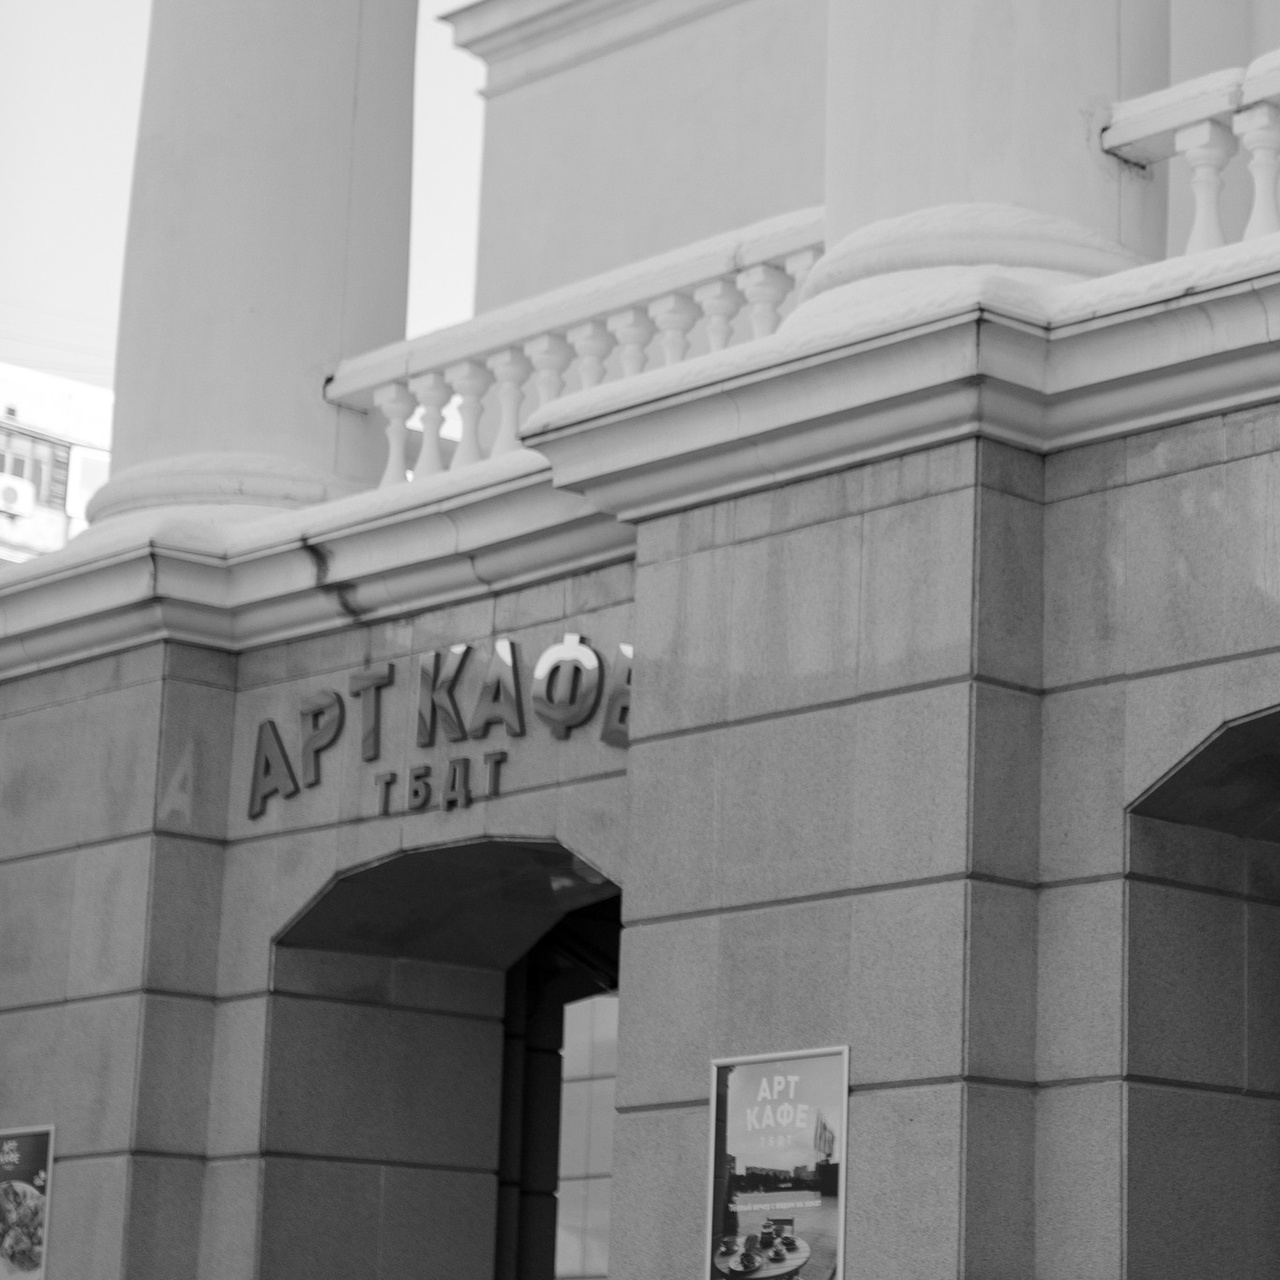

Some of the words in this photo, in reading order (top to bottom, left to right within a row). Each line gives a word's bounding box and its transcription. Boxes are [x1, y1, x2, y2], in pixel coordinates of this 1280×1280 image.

[247, 663, 395, 819] АРТ
[374, 751, 508, 816] ТБДТ
[757, 1075, 800, 1101] АРТ
[746, 1102, 809, 1131] КАФЕ
